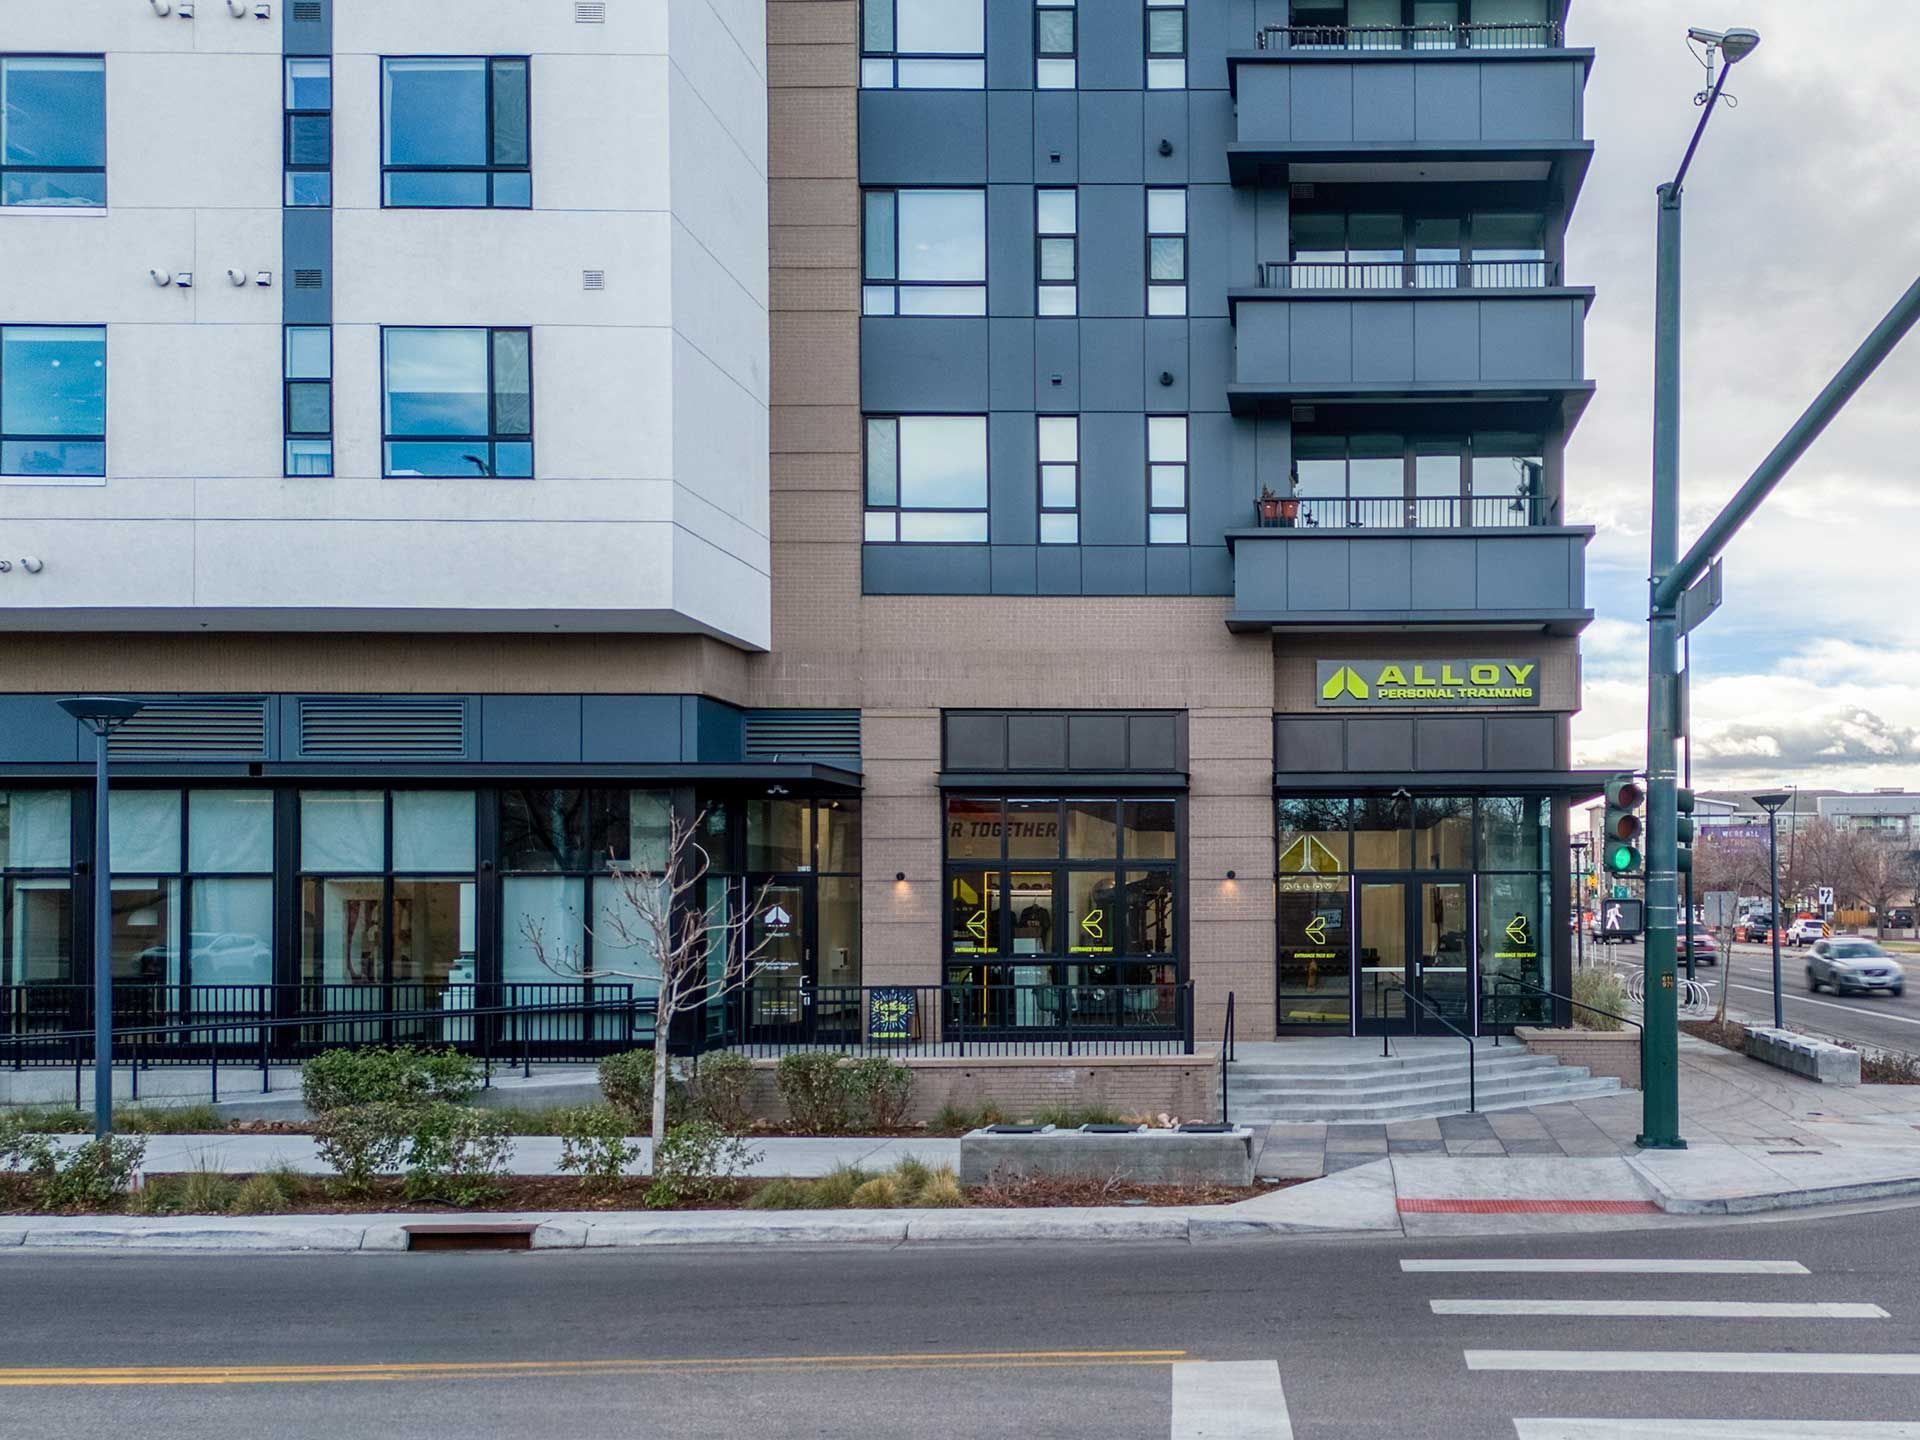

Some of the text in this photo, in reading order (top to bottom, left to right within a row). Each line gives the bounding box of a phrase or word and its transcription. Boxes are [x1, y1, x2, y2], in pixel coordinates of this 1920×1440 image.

[1376, 664, 1535, 685] ALLOY
[1378, 687, 1533, 699] PERSONAL TRAINING
[971, 822, 1057, 837] TOGETHER
